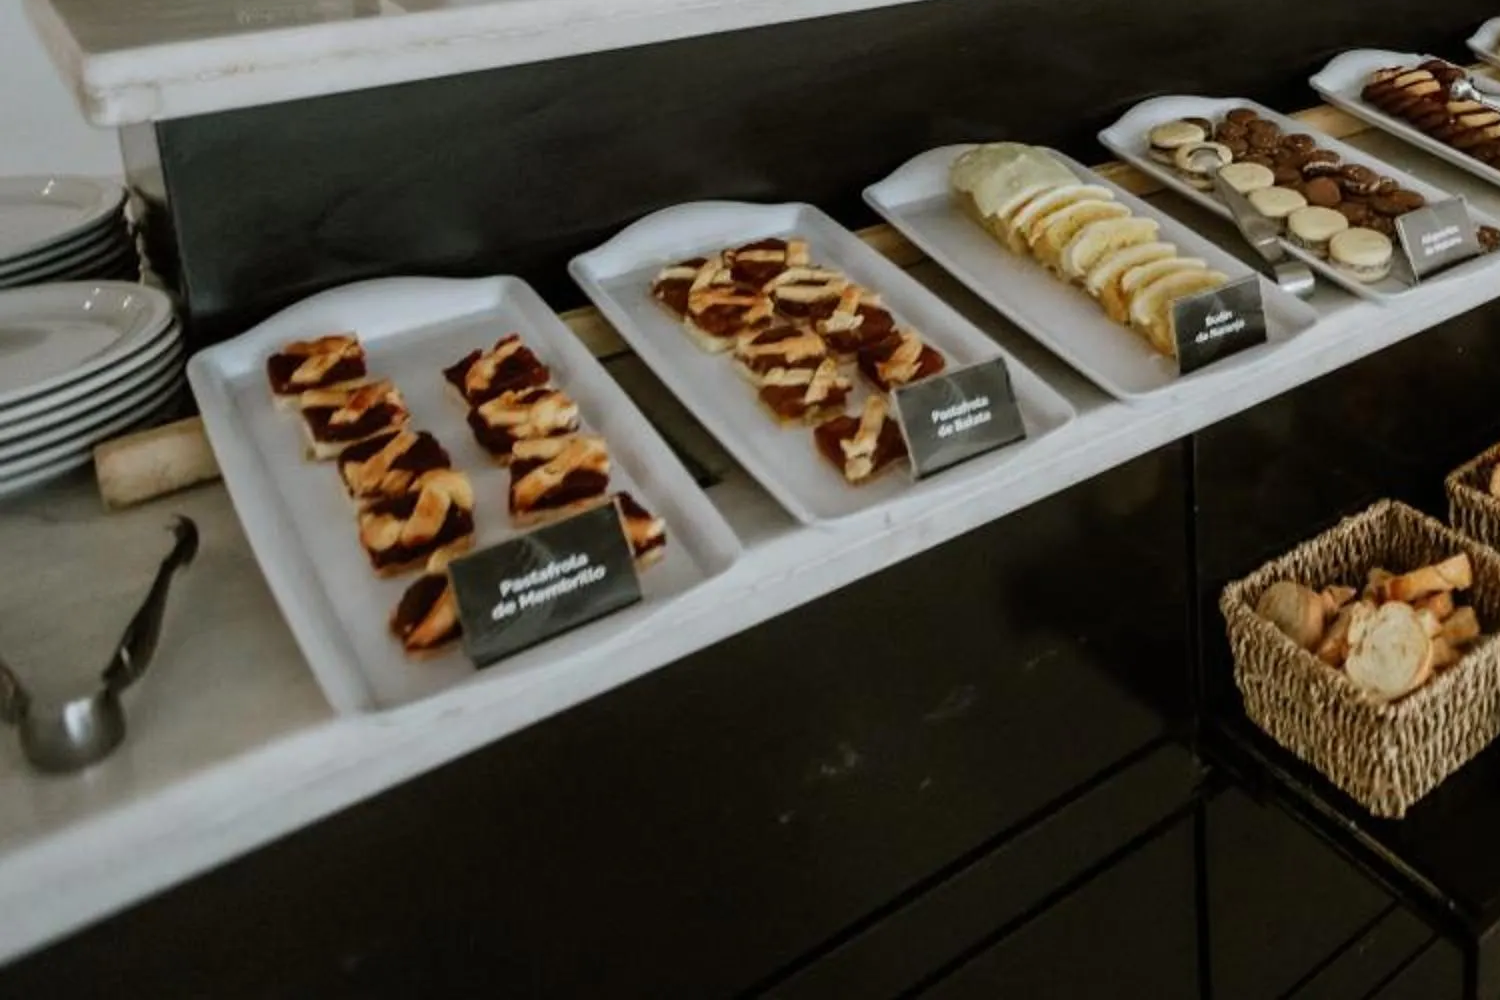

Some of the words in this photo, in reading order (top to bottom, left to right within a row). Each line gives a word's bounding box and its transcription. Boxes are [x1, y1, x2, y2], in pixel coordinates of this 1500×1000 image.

[491, 600, 517, 622] de
[518, 564, 607, 610] Membrillo
[499, 552, 590, 597] Pastafrola
